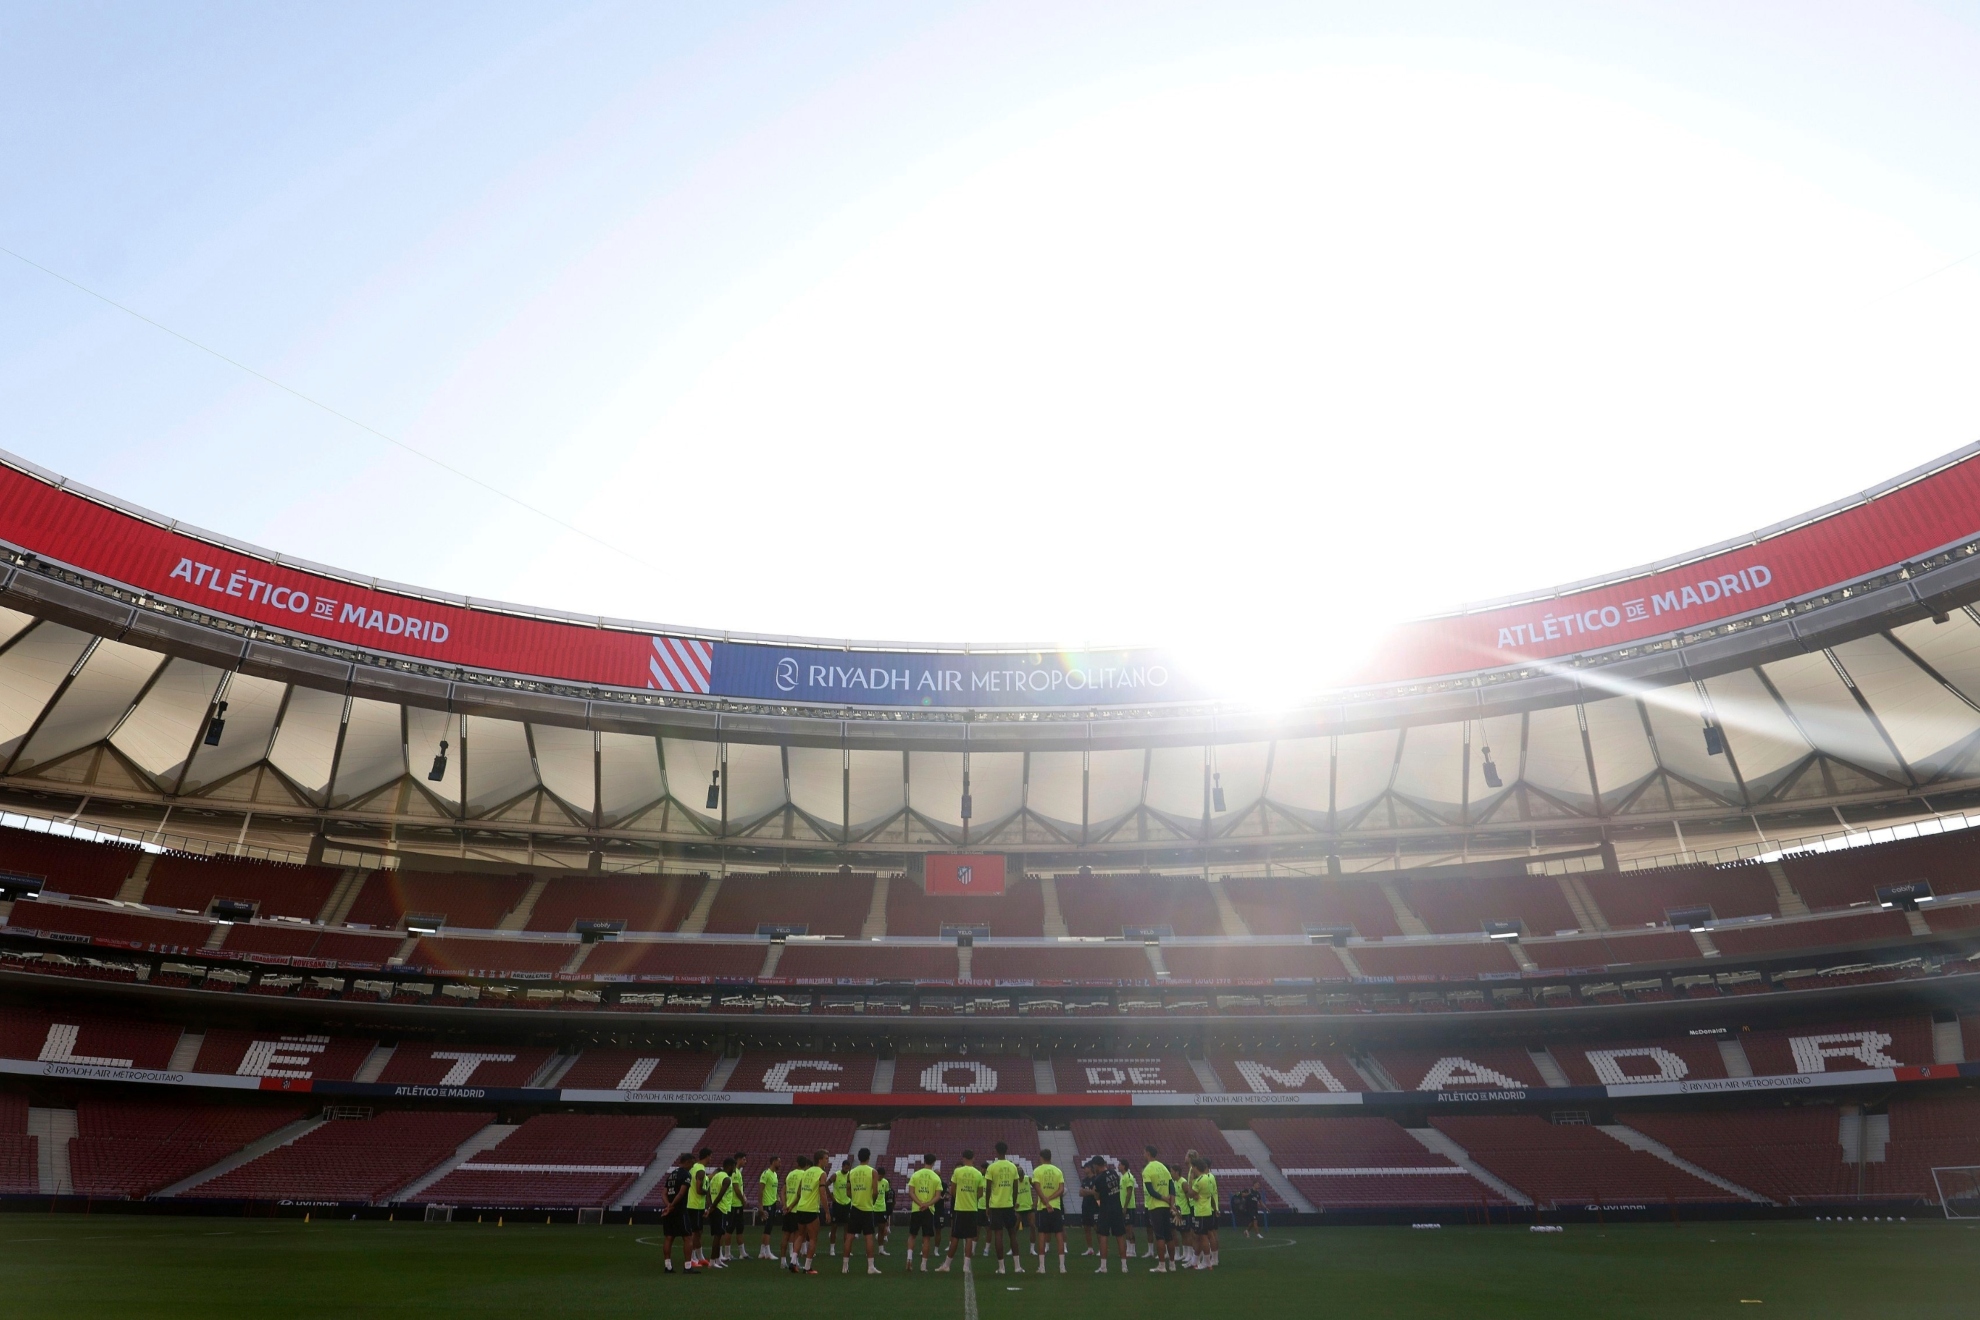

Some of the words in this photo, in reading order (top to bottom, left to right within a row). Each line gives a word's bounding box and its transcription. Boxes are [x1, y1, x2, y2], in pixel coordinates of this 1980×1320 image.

[170, 558, 309, 613] ATLÉTICO
[315, 601, 334, 616] DE
[339, 603, 449, 643] MADRID
[1498, 606, 1621, 648] ATLÉTICO
[1625, 604, 1646, 618] DE
[1651, 565, 1772, 616] MADRID
[809, 664, 911, 691] RIYADH
[916, 669, 963, 692] AIR
[971, 665, 1168, 692] METROPOLITANO
[1892, 885, 1914, 893] cabify
[1689, 1027, 1728, 1035] McDonald's
[55, 1066, 92, 1076] RIYADH
[94, 1070, 110, 1078] AIR
[112, 1072, 184, 1082] METROPOLITANO
[1742, 1076, 1812, 1088] METROPOLITANO
[395, 1085, 438, 1096] ATLÉTICO
[448, 1088, 485, 1098] MADRID
[632, 1092, 660, 1100] RIYADH
[676, 1094, 731, 1102] METROPOLITANO
[1438, 1091, 1479, 1102] ATLÉTICO
[1489, 1091, 1526, 1100] MADRID
[1202, 1095, 1230, 1103] RIYADH
[1232, 1095, 1244, 1103] AIR
[1245, 1095, 1300, 1103] METROPOLITANO
